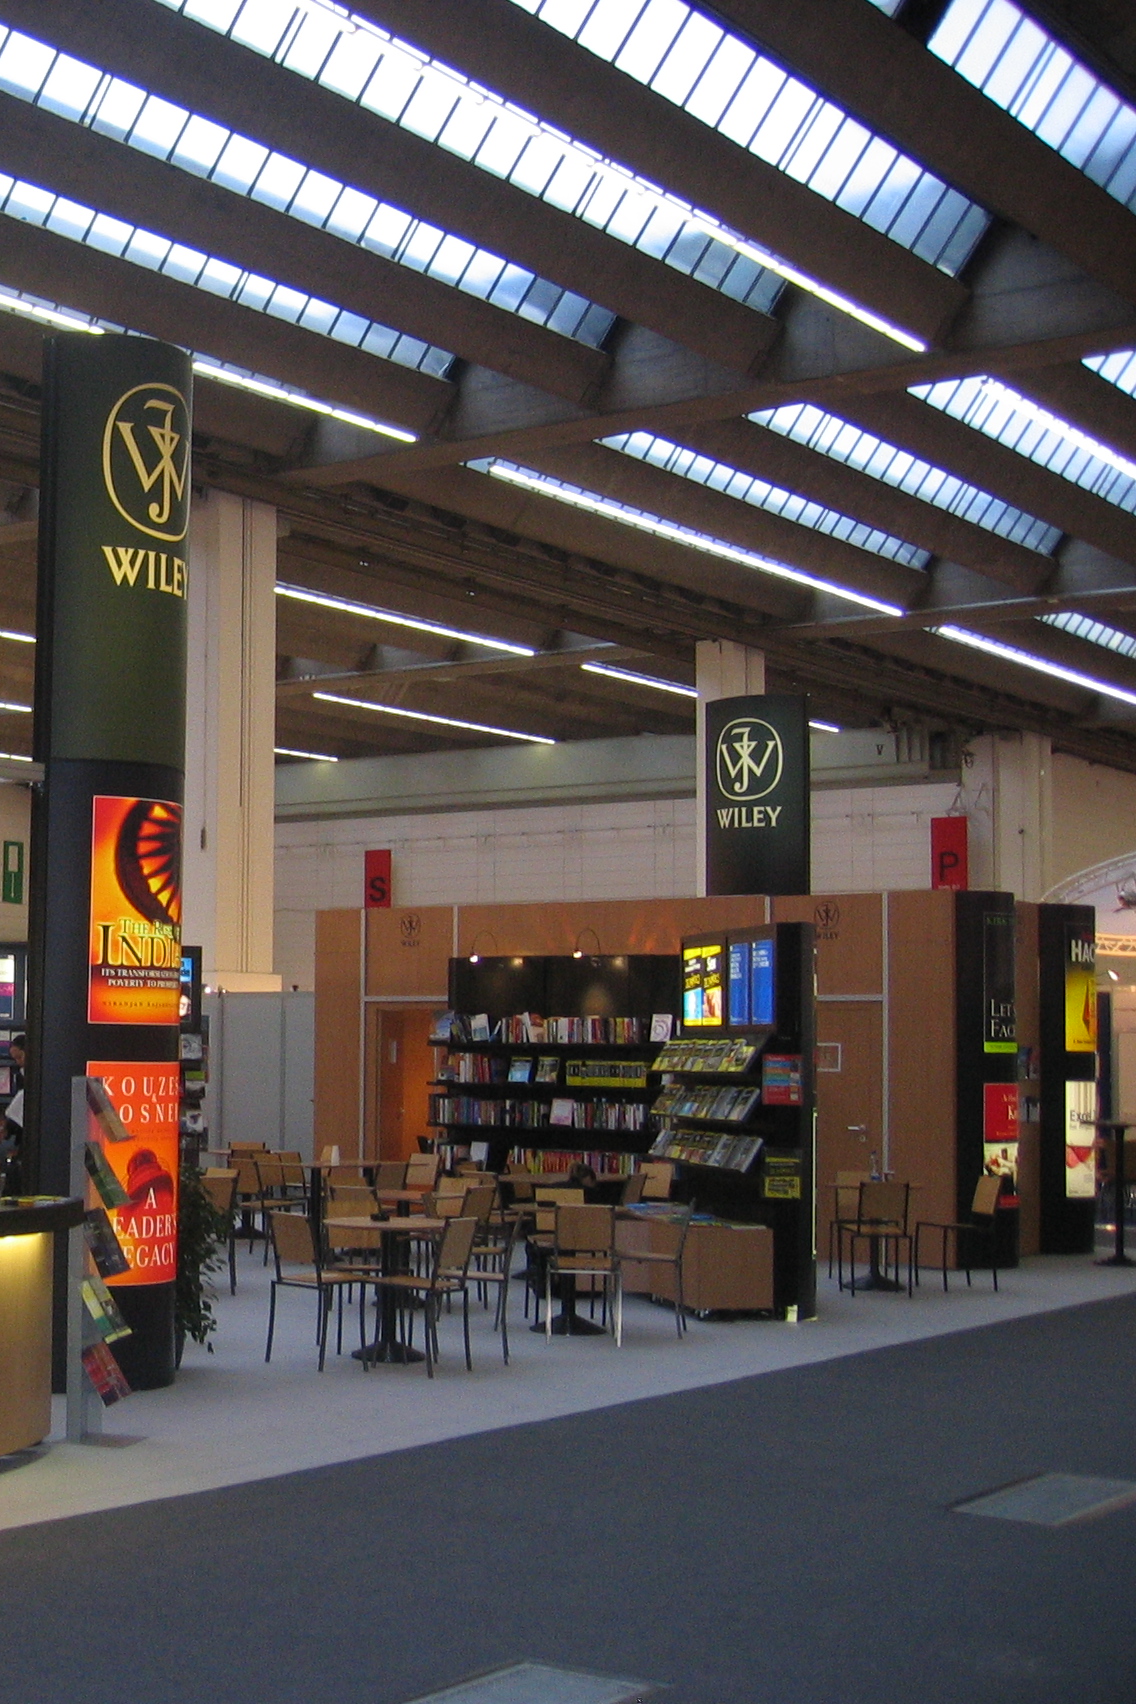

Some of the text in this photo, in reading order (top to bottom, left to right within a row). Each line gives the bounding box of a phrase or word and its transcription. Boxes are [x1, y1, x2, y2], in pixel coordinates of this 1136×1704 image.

[101, 545, 188, 600] WILEY
[716, 805, 783, 829] WILEY
[939, 851, 959, 882] P
[369, 876, 387, 902] S
[119, 1103, 179, 1124] OSNE
[144, 1187, 157, 1209] A
